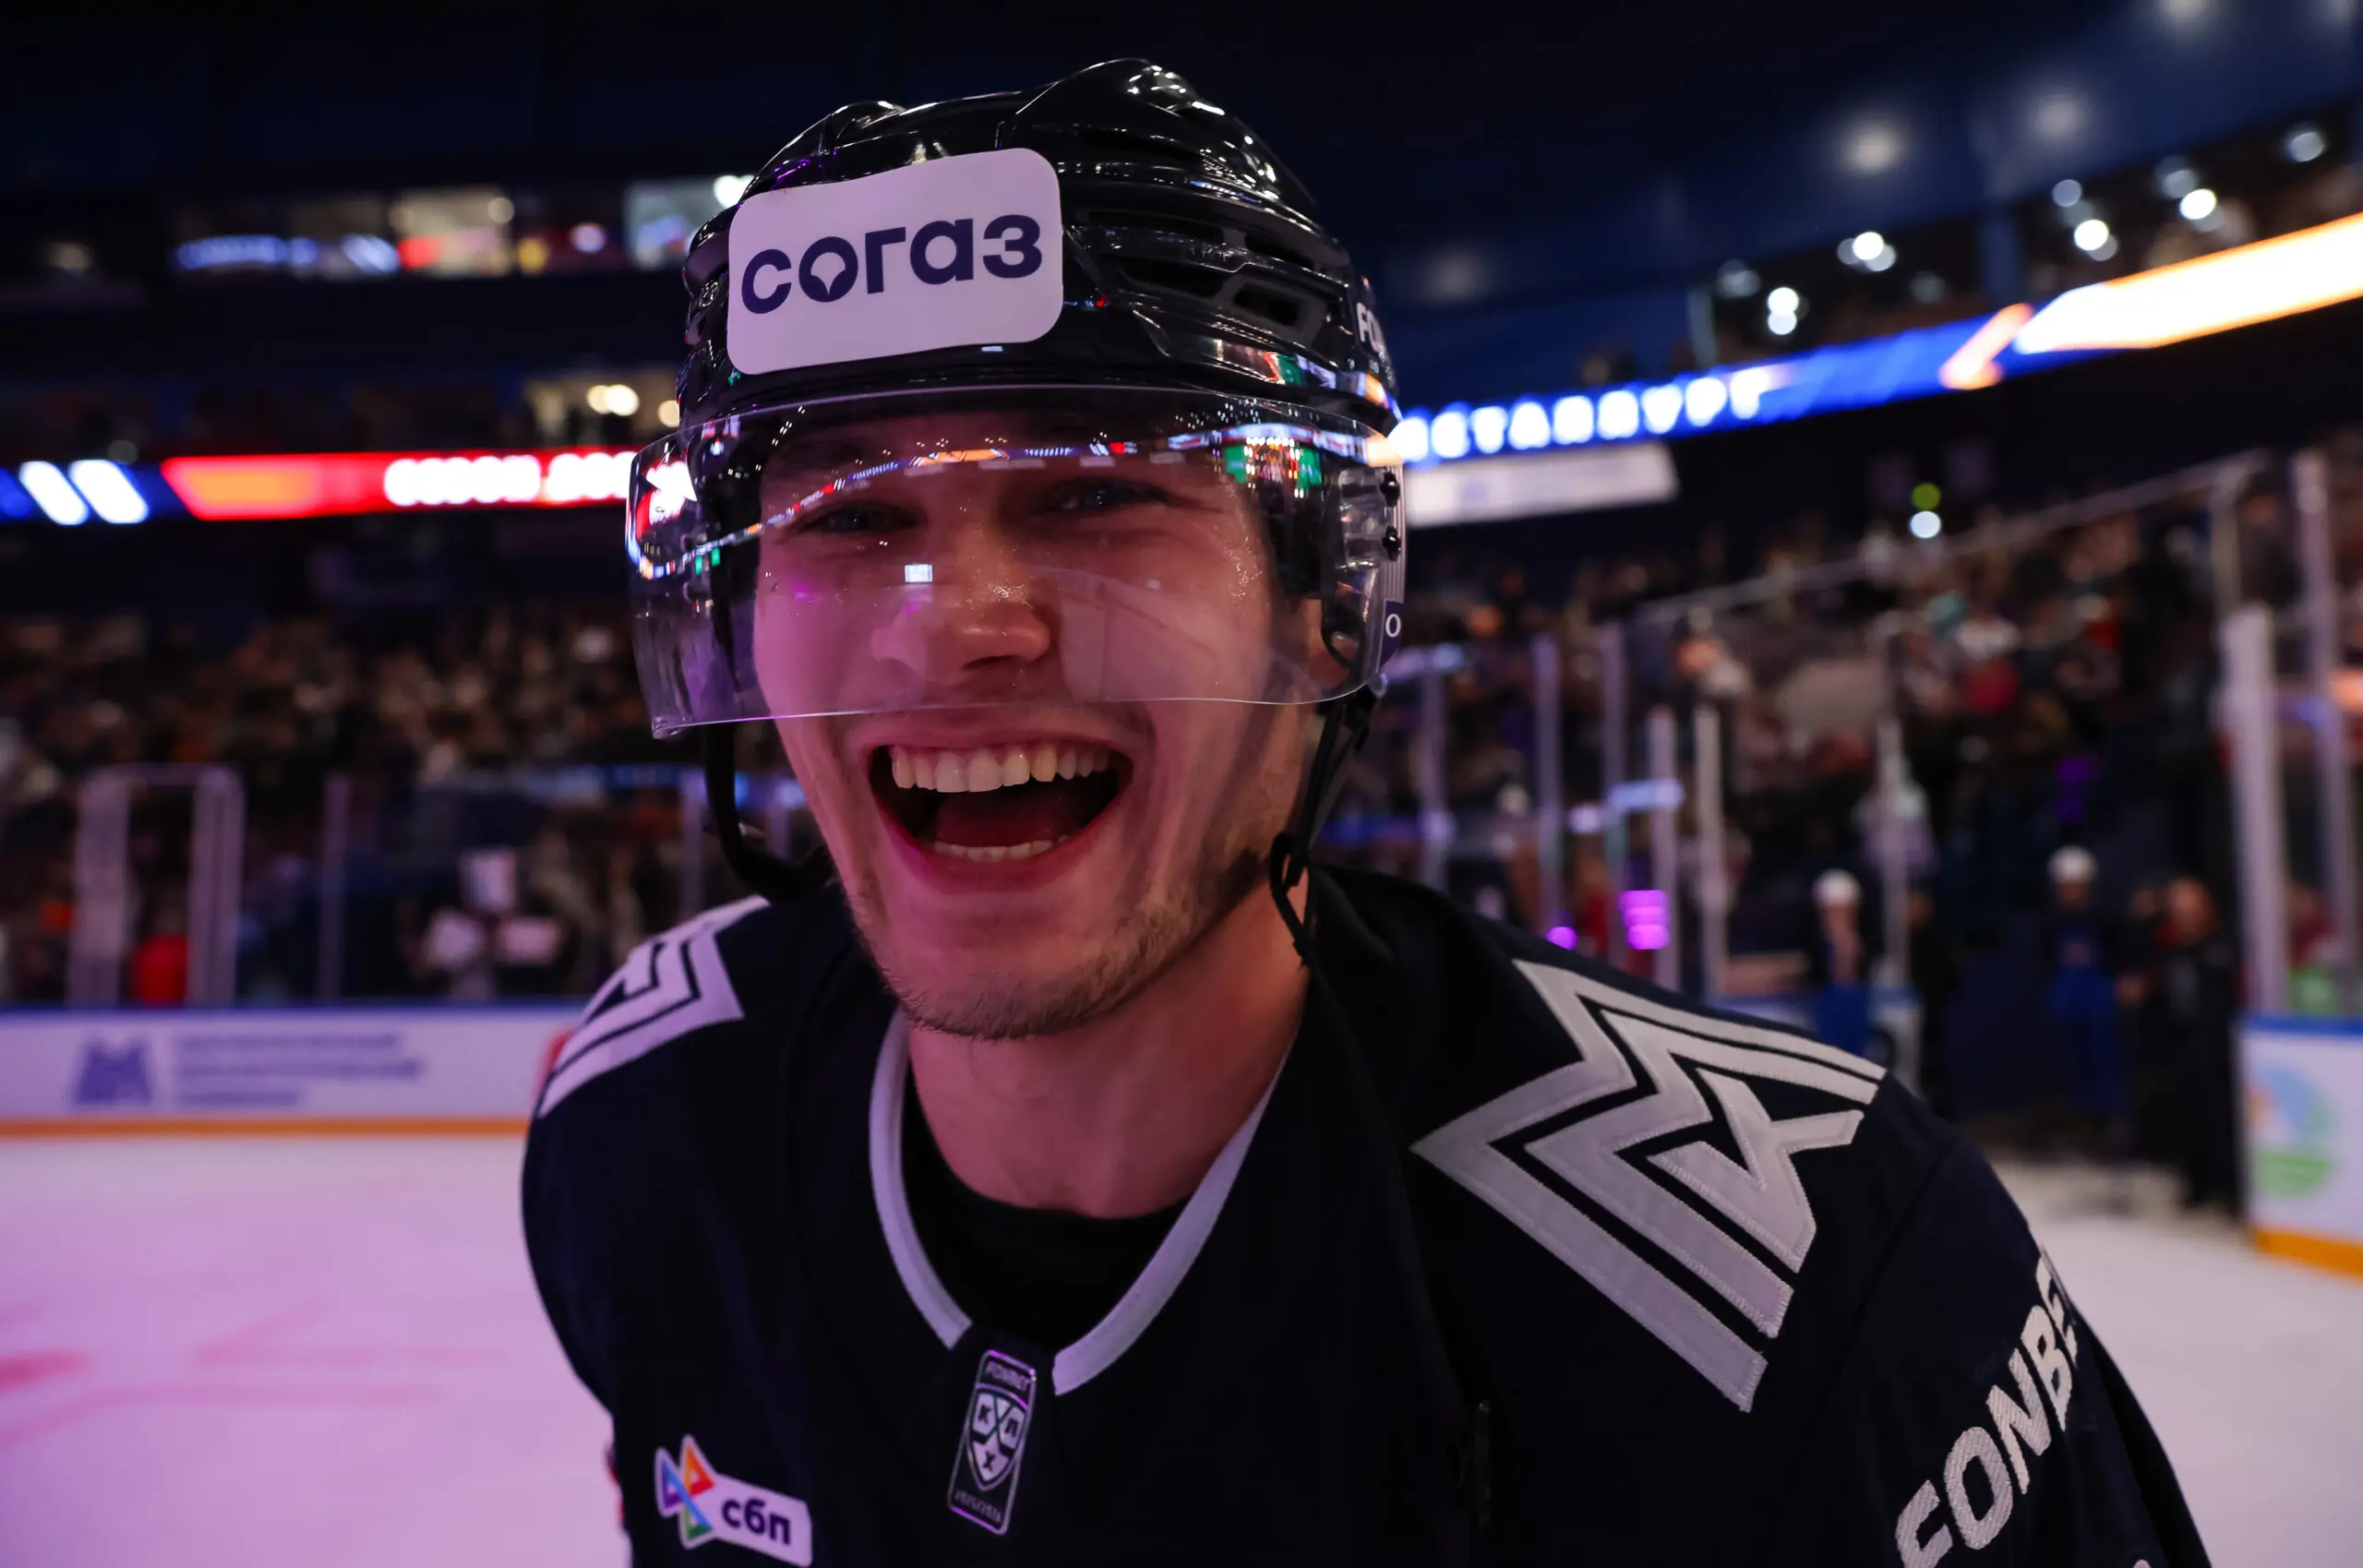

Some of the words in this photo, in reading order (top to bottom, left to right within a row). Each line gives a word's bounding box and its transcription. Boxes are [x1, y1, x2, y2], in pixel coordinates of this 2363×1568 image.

[741, 213, 1043, 315] согаз
[1895, 1248, 2079, 1568] FONBE
[720, 1496, 791, 1546] сбп
